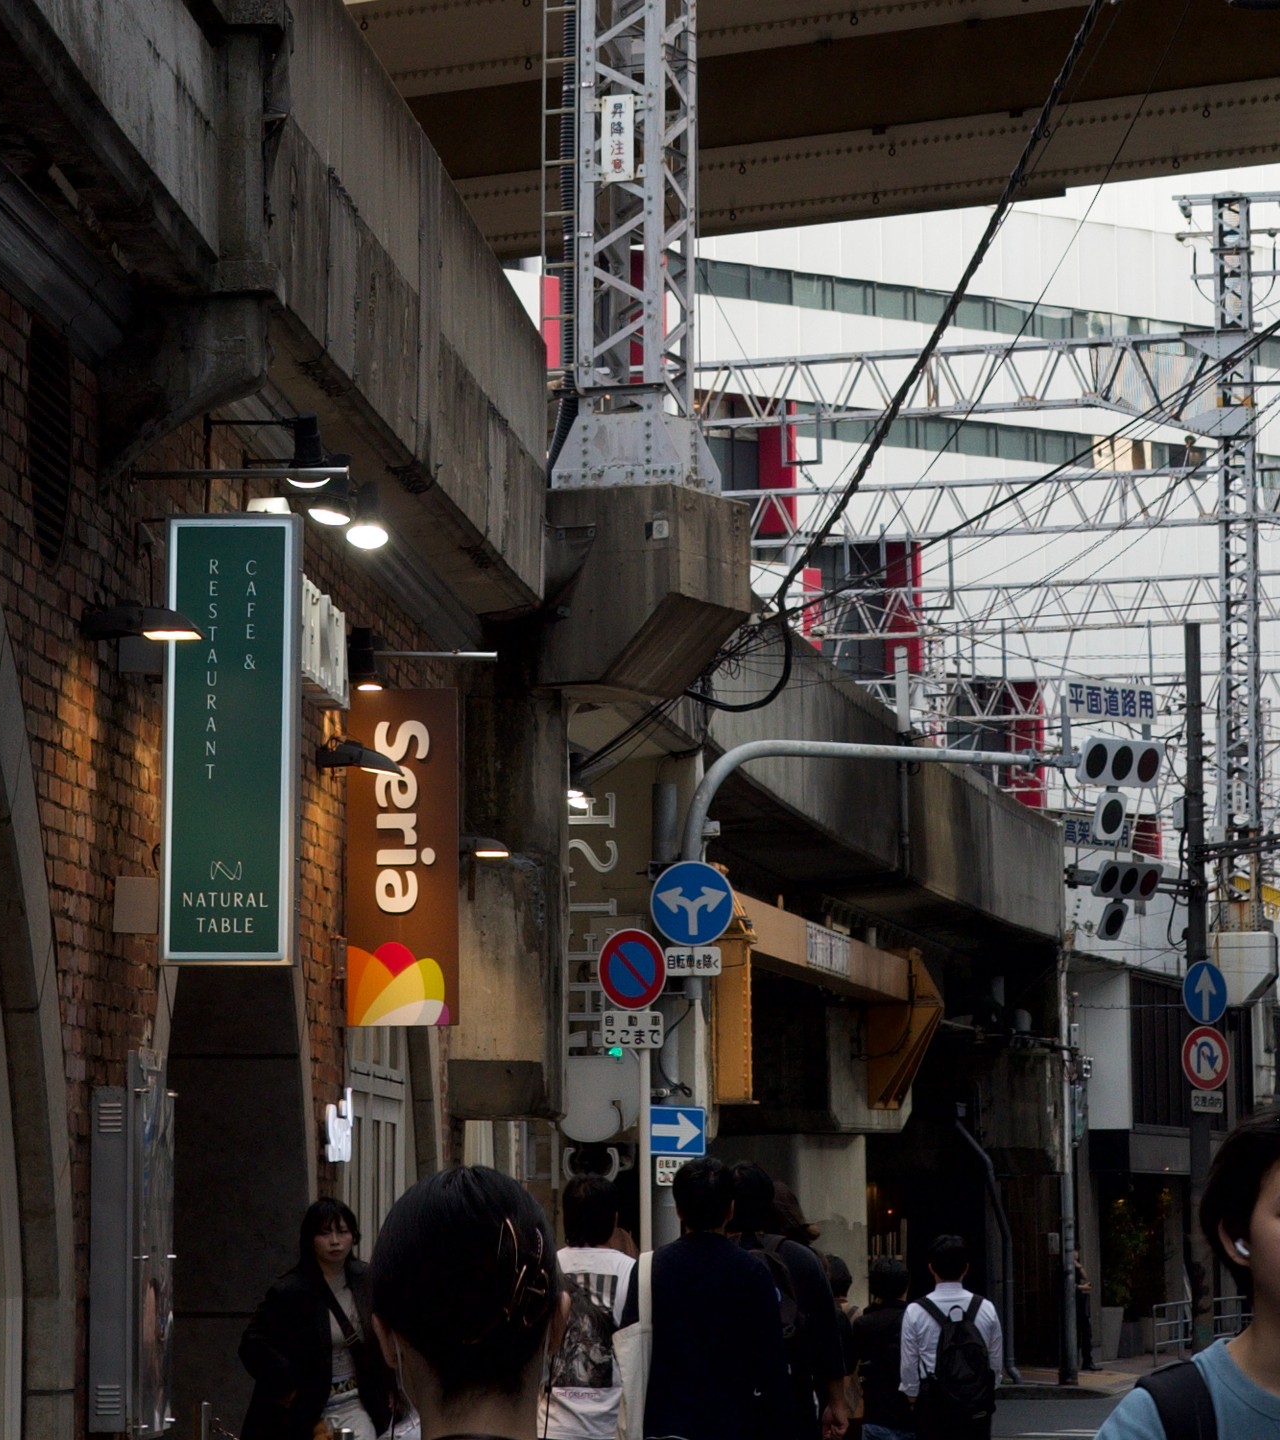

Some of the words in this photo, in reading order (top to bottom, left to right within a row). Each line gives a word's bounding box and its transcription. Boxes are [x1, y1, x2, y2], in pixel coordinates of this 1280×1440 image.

[245, 559, 257, 640] CAFE
[205, 558, 219, 780] RESTAURANT
[243, 653, 256, 670] &
[1068, 683, 1154, 720] 平面道路用
[374, 719, 436, 914] Seria
[182, 891, 269, 908] NATURAL
[196, 917, 254, 934] TABLE
[605, 1029, 660, 1045] ここまで
